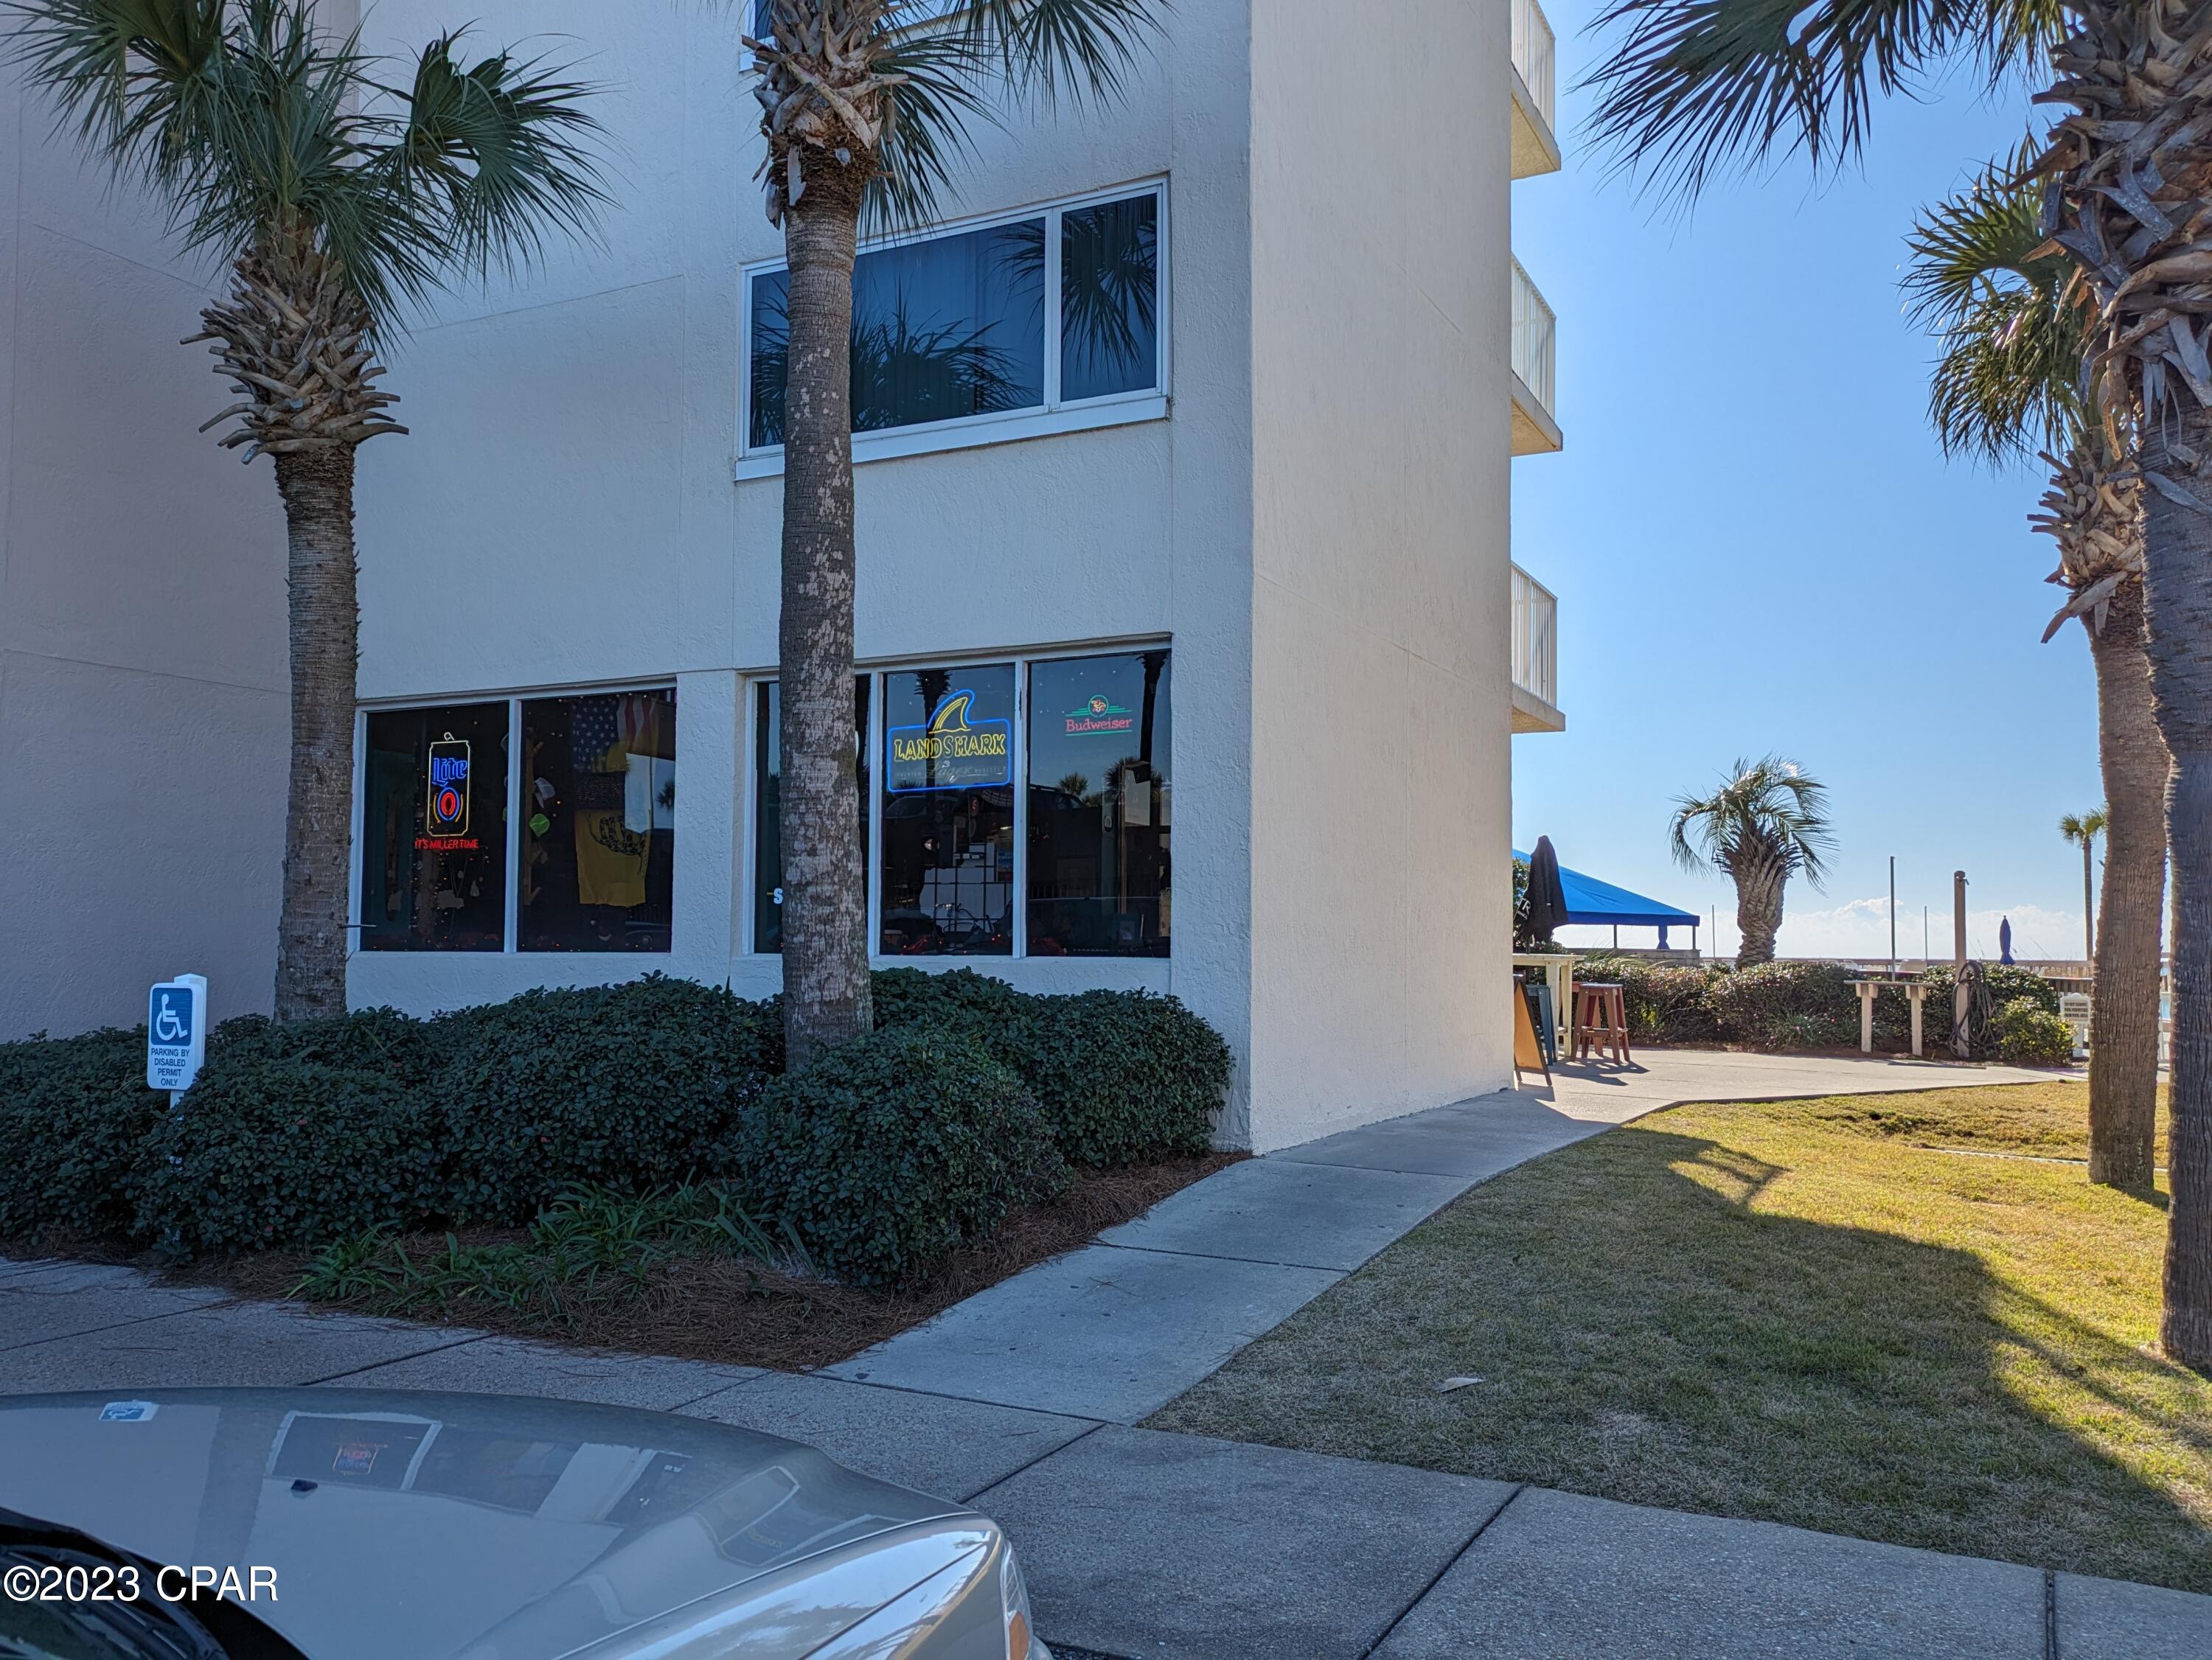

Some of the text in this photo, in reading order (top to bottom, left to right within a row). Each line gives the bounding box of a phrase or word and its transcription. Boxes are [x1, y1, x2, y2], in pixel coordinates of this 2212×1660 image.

[1065, 717, 1133, 732] Budweiser
[431, 757, 468, 787] Lite
[459, 839, 479, 849] TIME
[151, 1047, 189, 1057] PARKING BY
[154, 1058, 186, 1067] DISABLED
[158, 1068, 182, 1076] PERMIT
[161, 1078, 178, 1087] ONLY
